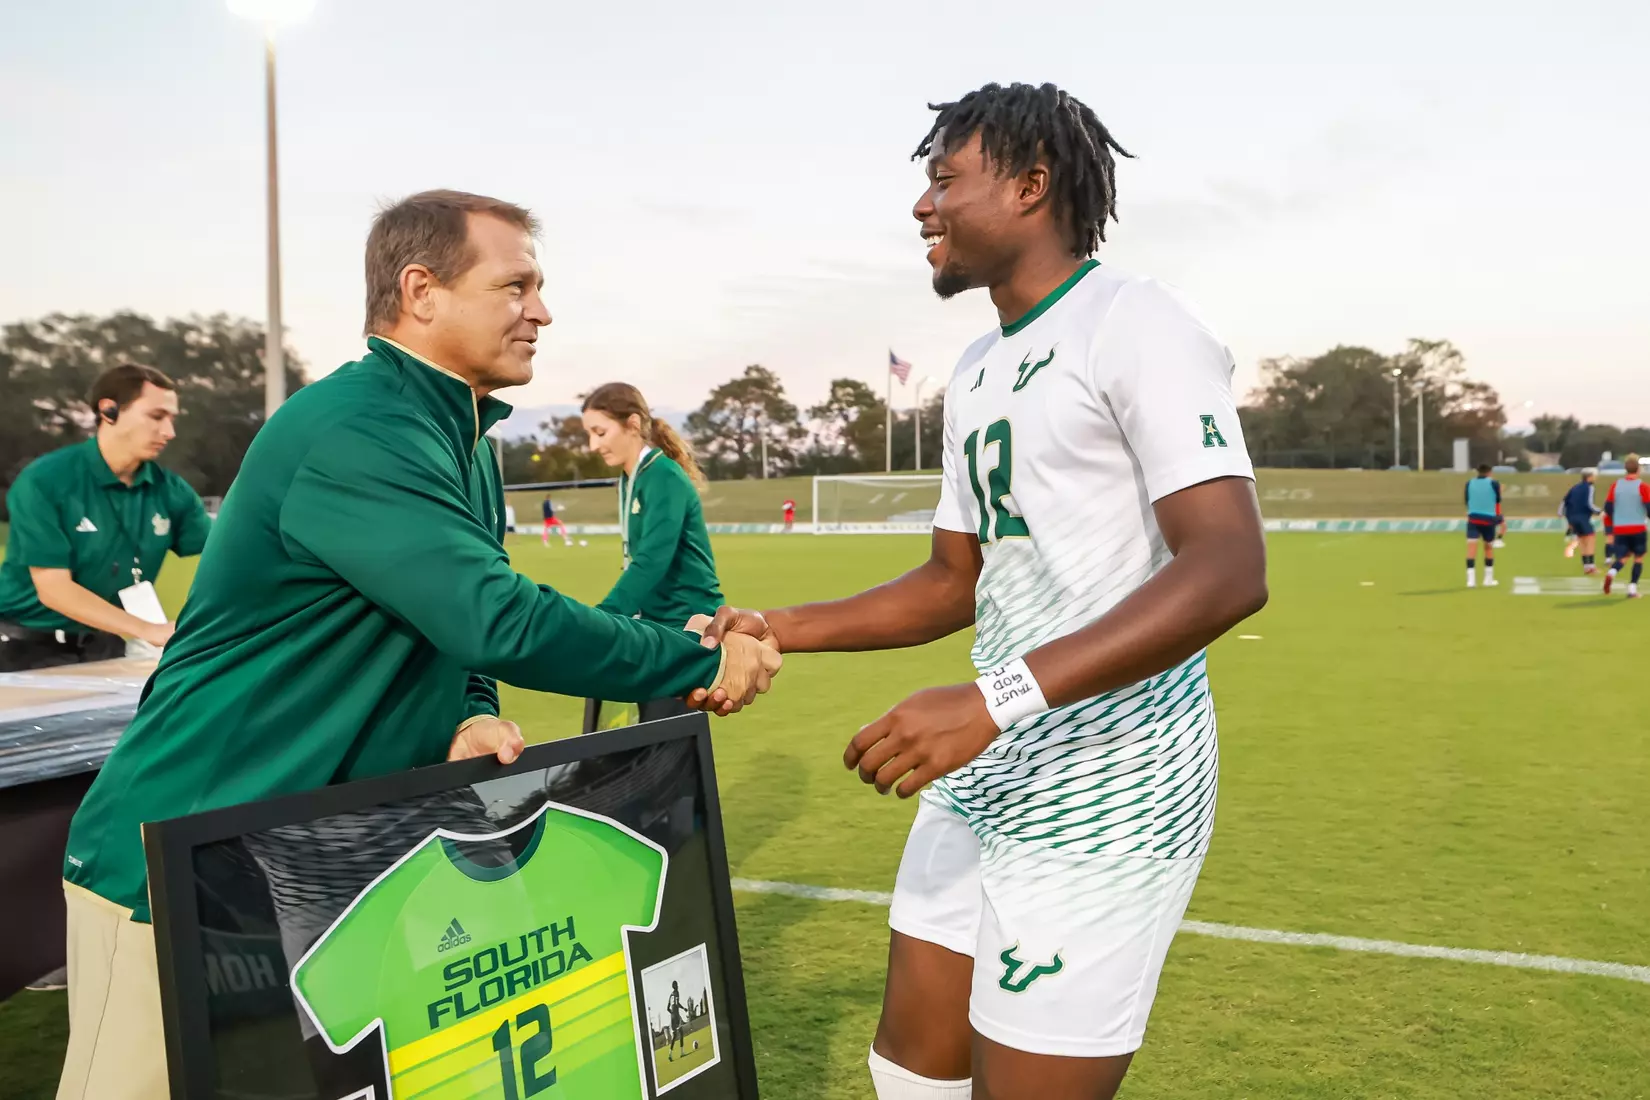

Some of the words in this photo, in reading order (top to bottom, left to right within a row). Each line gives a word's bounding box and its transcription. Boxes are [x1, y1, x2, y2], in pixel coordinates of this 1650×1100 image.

[963, 416, 1032, 546] 12
[993, 673, 1023, 691] GOD
[994, 683, 1033, 707] TRUST
[437, 933, 472, 953] adidas
[443, 915, 576, 992] SOUTH
[427, 941, 594, 1030] FLORIDA
[491, 1003, 557, 1100] 12
